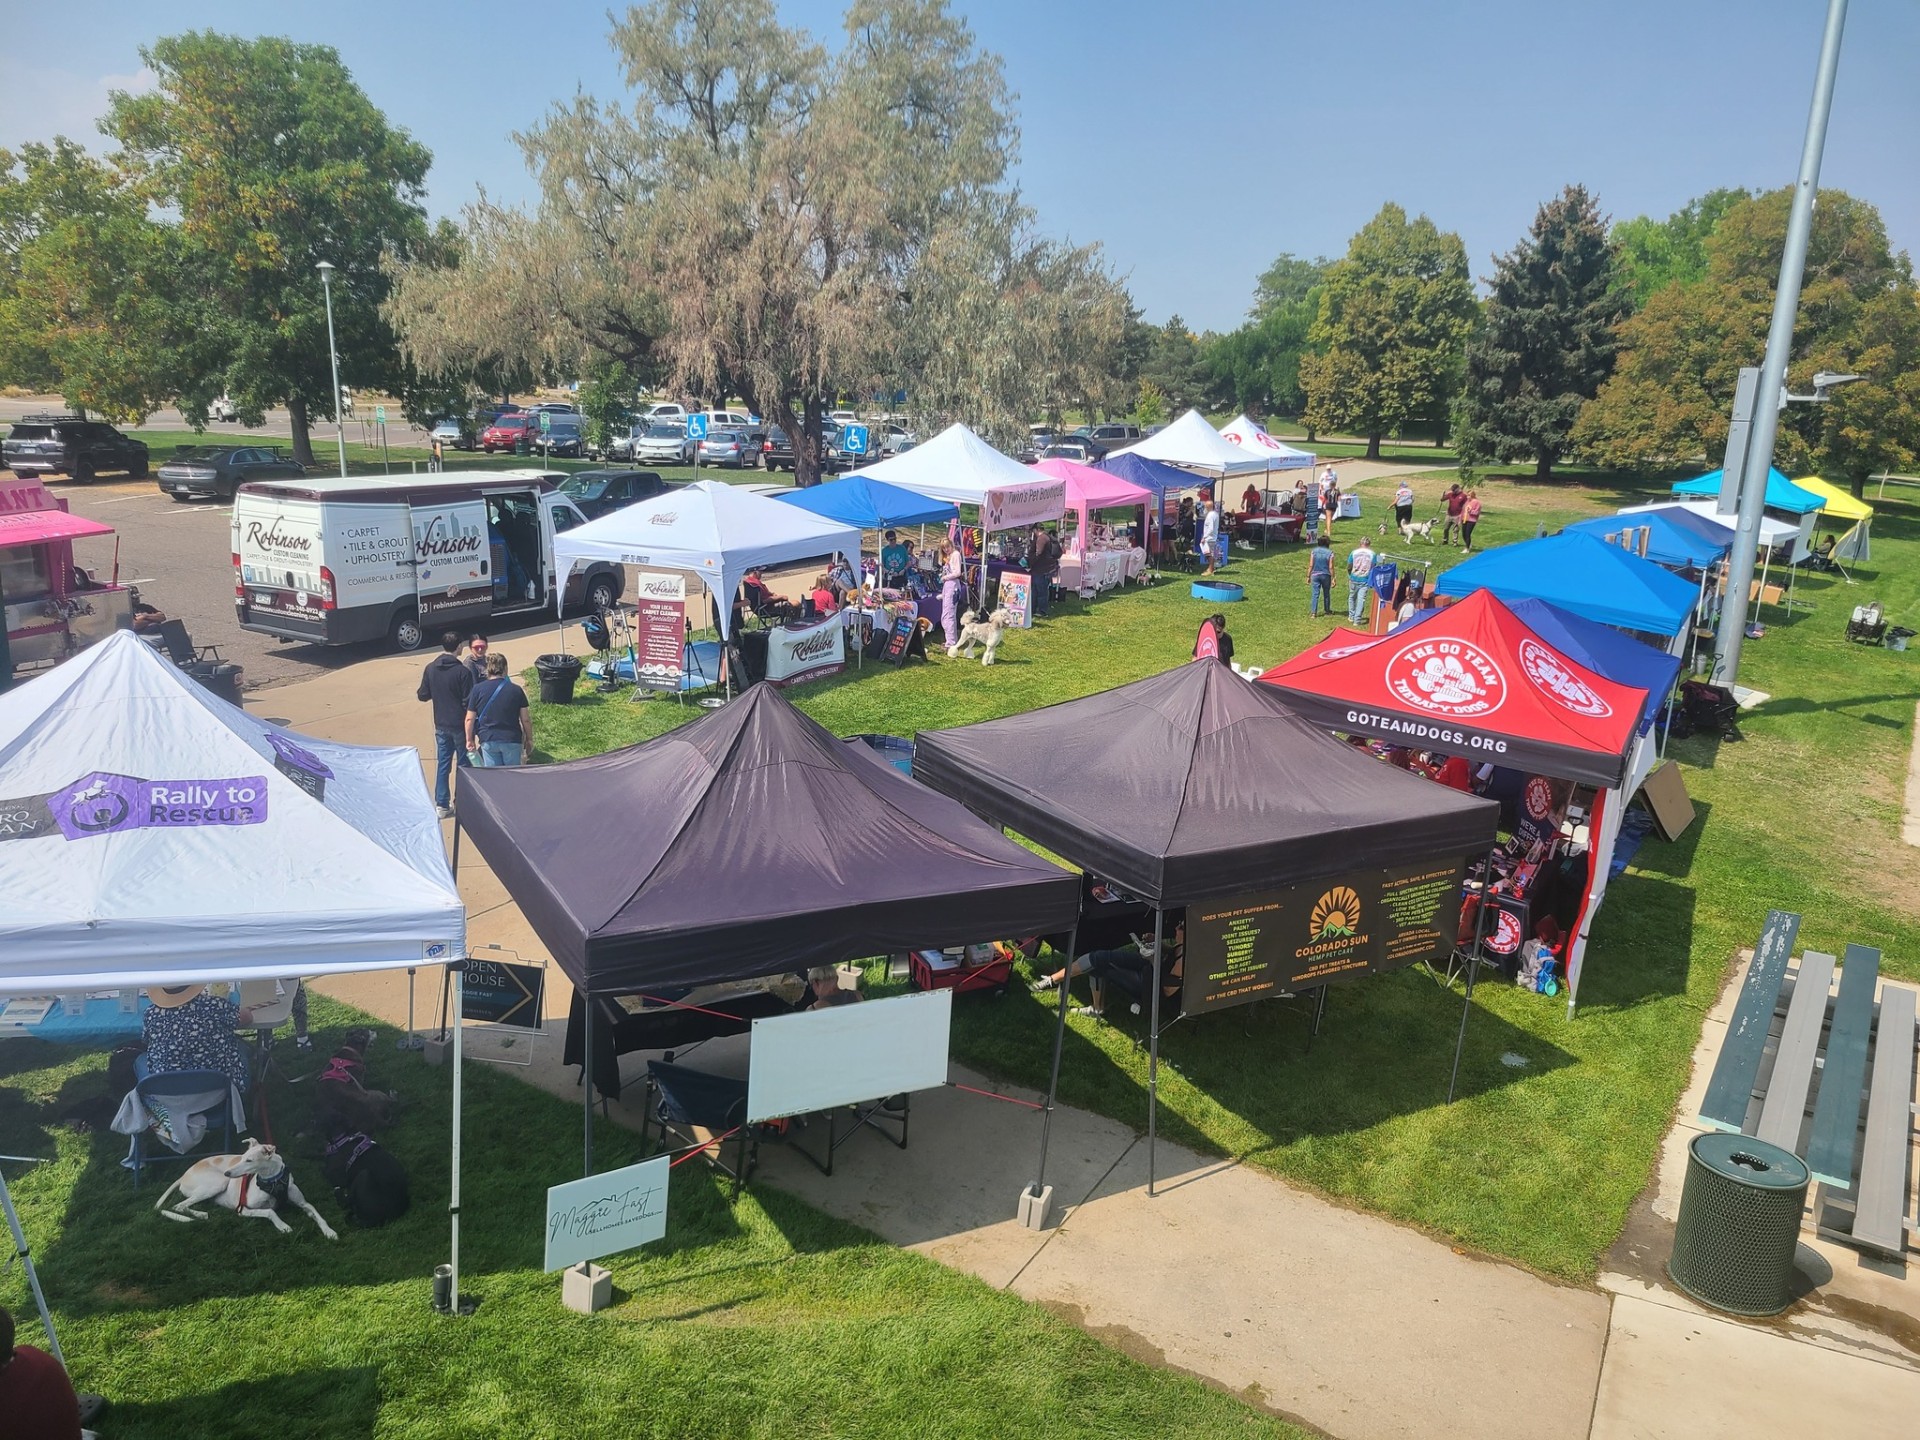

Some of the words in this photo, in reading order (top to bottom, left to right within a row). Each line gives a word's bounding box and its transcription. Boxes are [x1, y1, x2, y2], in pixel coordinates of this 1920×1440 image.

[1009, 491, 1028, 504] Twin's
[1029, 489, 1039, 502] Pet
[1040, 486, 1063, 500] Boutique
[247, 516, 311, 551] Robinson
[347, 526, 380, 538] CARPET
[416, 515, 482, 558] obinson
[349, 541, 367, 552] TILE
[369, 540, 375, 549] &
[378, 537, 408, 549] GROUT
[273, 549, 289, 558] CUSTOM
[290, 551, 309, 560] CLEANING
[351, 551, 406, 565] UPHOLSTERY
[430, 557, 452, 567] CUSTOM
[454, 554, 479, 565] CLEANING
[347, 575, 389, 586] COMMERCIAL
[390, 573, 394, 581] &
[644, 581, 680, 595] Robinson
[791, 631, 835, 661] Robinson
[1404, 644, 1435, 663] THE
[1439, 643, 1460, 655] GO
[1464, 650, 1498, 685] TEAM
[1434, 664, 1467, 680] Caring
[1412, 669, 1487, 696] Compassionate
[1394, 679, 1451, 712] THERAPY
[1453, 700, 1489, 713] DOGS
[1427, 683, 1469, 700] Canines
[1347, 711, 1508, 753] GOTEAMDOGS.ORG
[151, 786, 219, 808] Rally
[228, 786, 256, 804] to
[150, 805, 254, 823] Rescue
[1426, 870, 1447, 879] EFFECTIVE
[1380, 895, 1410, 904] ORGANICALLY
[1431, 884, 1453, 892] COLORADO
[1399, 886, 1419, 895] SPECTRUM
[1431, 880, 1448, 888] EXTRACT
[1416, 893, 1440, 903] EXTRACTION
[1243, 906, 1264, 914] SUFFER
[1228, 918, 1255, 926] ANXIETY?
[1233, 924, 1250, 932] PAIN?
[1407, 918, 1431, 926] APPROVED
[1221, 932, 1237, 940] JOINT
[1239, 929, 1261, 937] ISSUES?
[1226, 936, 1255, 945] SEIZURES?
[1402, 935, 1417, 943] OWNED
[1418, 931, 1440, 939] BUSINESS
[1228, 943, 1254, 951] TUMORS?
[1295, 939, 1348, 958] COLORADO
[1349, 934, 1369, 946] SUN
[1226, 955, 1253, 964] INJURIES?
[1227, 949, 1254, 958] SURGERY?
[1308, 953, 1325, 962] HEMP
[1337, 947, 1354, 955] CARE
[1239, 960, 1252, 968] AGE?
[1328, 959, 1345, 967] TREATS
[1209, 972, 1227, 980] OTHER
[1227, 968, 1246, 976] HEALTH
[1247, 963, 1268, 972] ISSUES?
[1291, 972, 1317, 982] SUNDROPS
[1317, 967, 1340, 976] FLAVORED
[1342, 961, 1367, 970] TINCTURES
[1227, 989, 1237, 997] CBD
[549, 1206, 612, 1243] Maggie
[615, 1186, 663, 1221] Fast
